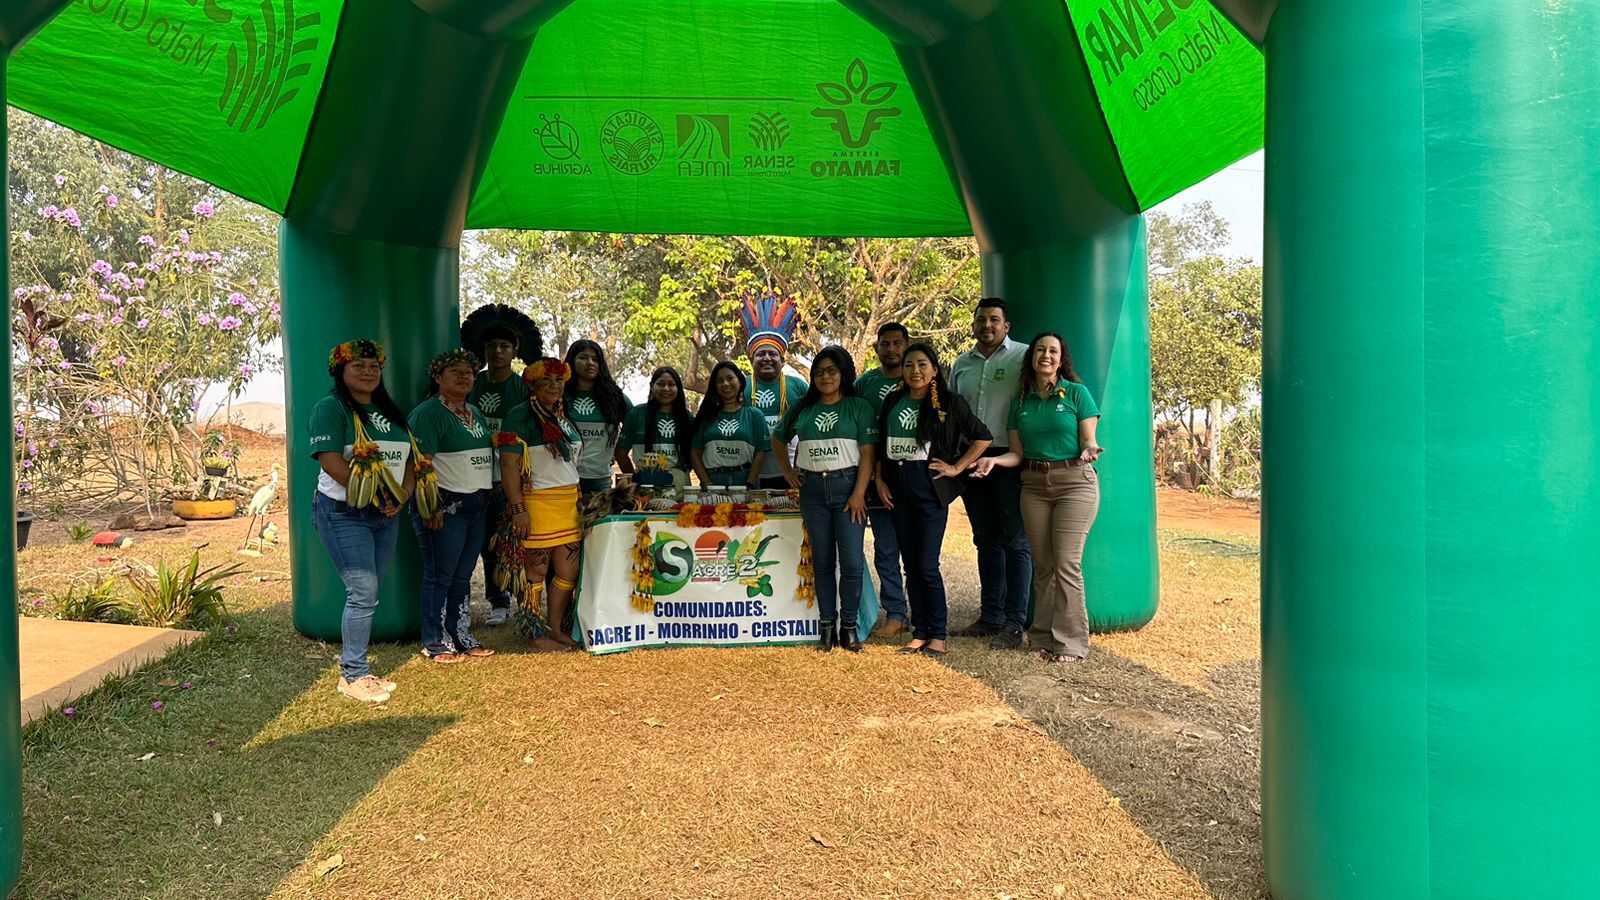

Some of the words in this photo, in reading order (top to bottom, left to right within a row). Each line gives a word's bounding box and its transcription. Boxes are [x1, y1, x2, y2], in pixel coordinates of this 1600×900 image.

[716, 446, 741, 455] SENAR
[808, 446, 839, 457] SENAR
[891, 444, 917, 454] SENAR
[739, 555, 759, 577] 2
[653, 600, 767, 618] COMUNIDADES:
[587, 626, 632, 646] SACRE
[635, 624, 646, 641] II
[657, 622, 739, 639] MORRINHO
[751, 619, 820, 638] CRISTALI
